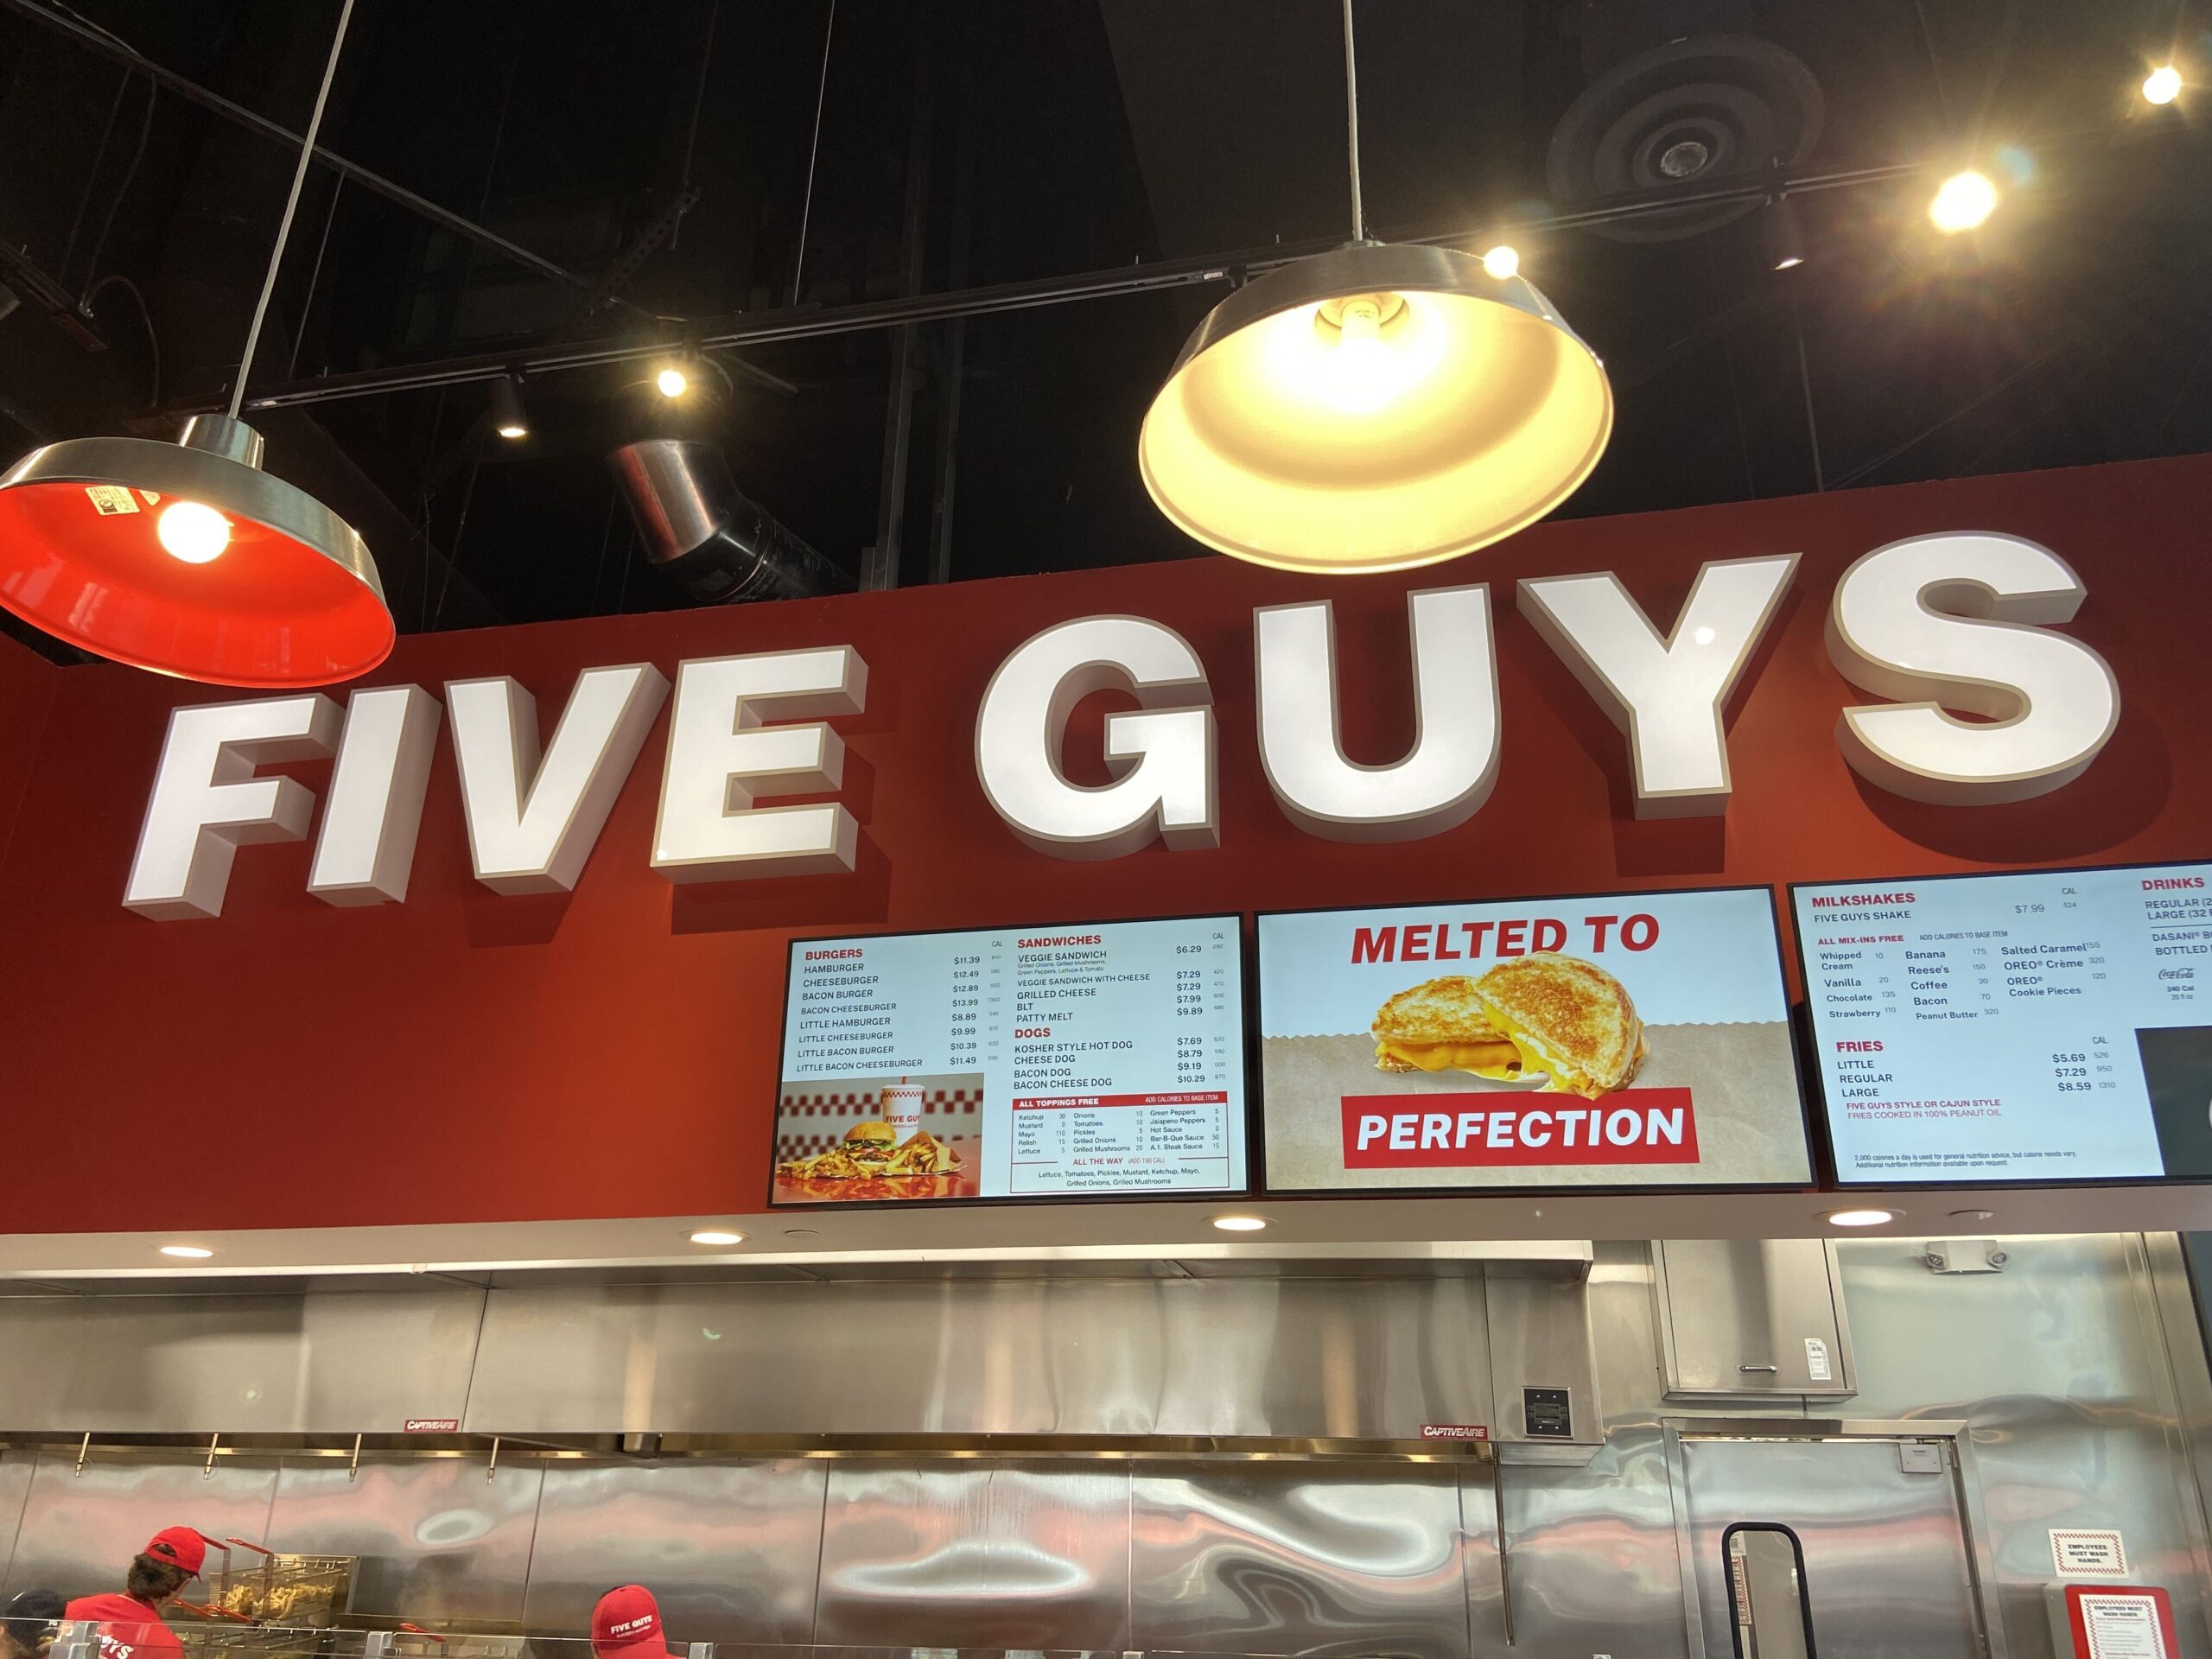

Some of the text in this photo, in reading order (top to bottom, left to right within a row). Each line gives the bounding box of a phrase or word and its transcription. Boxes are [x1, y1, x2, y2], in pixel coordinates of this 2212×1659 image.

[122, 531, 2121, 921] FIVE GUYS
[2142, 877, 2204, 890] DRINKS
[1812, 893, 1915, 907] MILKSHAKES
[2145, 899, 2199, 909] REGULAR
[2016, 905, 2044, 914] $7.99
[2147, 910, 2207, 919] LARGE (32
[1815, 911, 1910, 923] FIVE GUYS SHAKE
[1018, 935, 1101, 948] SANDWICHES
[1351, 913, 1660, 964] MELTED TO
[2001, 943, 2087, 955] Salted Caramel
[2155, 945, 2208, 955] BOTTLED
[805, 949, 862, 960] BURGERS
[1019, 950, 1106, 963] VEGGIE SANDWICH
[1820, 951, 1861, 960] Whipped
[1905, 950, 1945, 959] Banana
[804, 963, 864, 974] HAMBURGER
[2046, 960, 2083, 969] Crème
[1908, 966, 1949, 975] Reese's
[804, 976, 878, 987] CHEESEBURGER
[1049, 976, 1093, 985] SANDWICH
[1824, 979, 1861, 988] Vanilla
[1910, 982, 1948, 990] Coffee
[803, 989, 873, 1001] BACON BURGER
[1017, 988, 1096, 1000] GRILLED CHEESE
[2010, 987, 2081, 997] Cookie Pieces
[1914, 997, 1948, 1006] Bacon
[832, 1003, 896, 1013] CHEESEBURGER
[1016, 1014, 1046, 1022] PATTY
[800, 1018, 891, 1029] LITTLE HAMBURGER
[827, 1032, 893, 1041] CHEESEBURGER
[1014, 1027, 1051, 1038] DOGS
[860, 1046, 893, 1055] BURGER
[1014, 1044, 1054, 1053] KOSHER
[1057, 1043, 1087, 1052] STYLE
[1836, 1041, 1883, 1052] FRIES
[1014, 1056, 1052, 1065] CHEESE
[2052, 1054, 2085, 1063] $5.69
[825, 1062, 854, 1071] BACON
[856, 1059, 922, 1069] CHEESEBURGER
[1838, 1060, 1874, 1069] LITTLE
[1051, 1068, 1071, 1077] DOG
[2055, 1068, 2087, 1077] $7.29
[1840, 1074, 1892, 1083] REGULAR
[1014, 1080, 1047, 1090] BACON
[1050, 1079, 1089, 1088] CHEESE
[2058, 1082, 2091, 1091] $8.59
[1842, 1089, 1879, 1097] LARGE
[1357, 1108, 1684, 1151] PERFECTION
[611, 1623, 630, 1634] FIVE
[632, 1615, 652, 1628] GUYS
